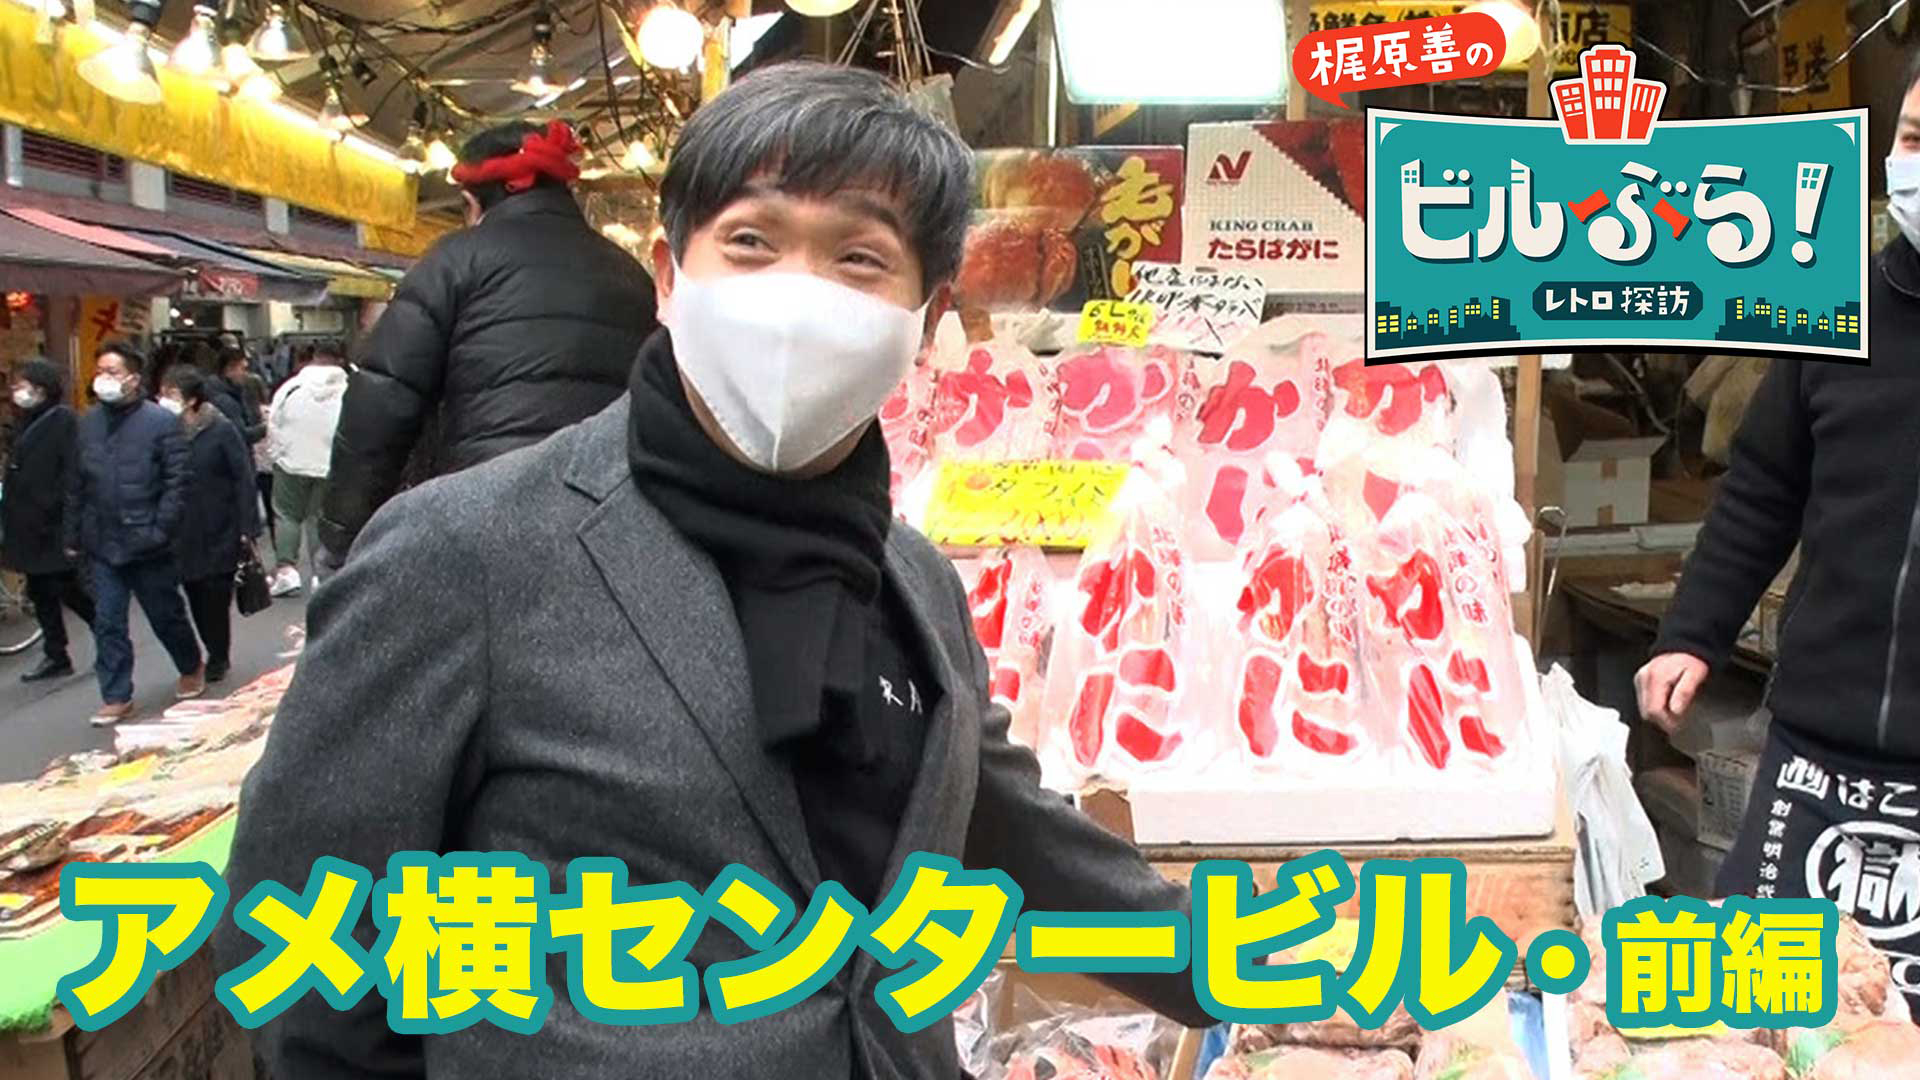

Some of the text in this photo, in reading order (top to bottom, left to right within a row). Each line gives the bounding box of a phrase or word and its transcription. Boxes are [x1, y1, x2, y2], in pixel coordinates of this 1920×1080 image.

[1209, 220, 1313, 231] KING CRAB
[1207, 238, 1339, 260] たらばがに
